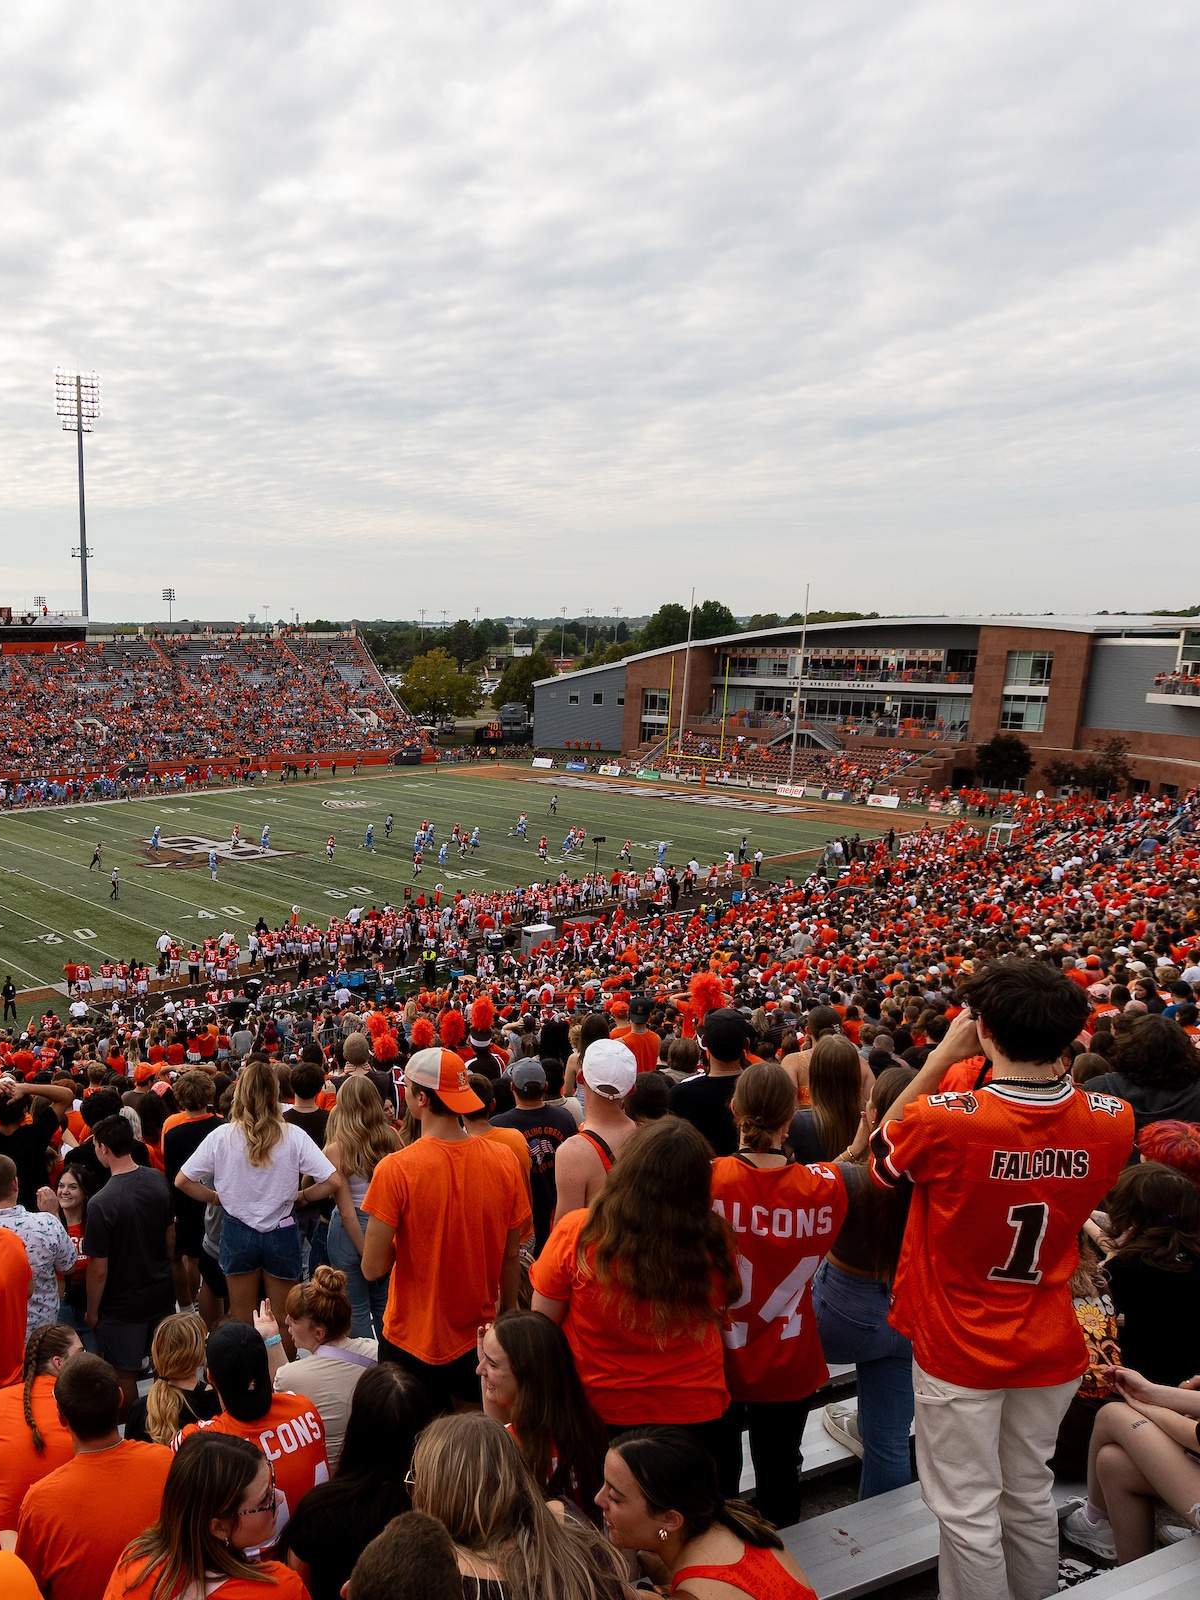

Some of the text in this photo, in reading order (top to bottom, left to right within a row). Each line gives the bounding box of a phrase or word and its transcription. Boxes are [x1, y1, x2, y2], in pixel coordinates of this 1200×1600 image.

[488, 722, 499, 731] 40
[21, 766, 110, 779] FOOTBALL
[778, 785, 803, 796] meijer
[444, 868, 487, 880] 40
[323, 885, 374, 899] 50
[198, 905, 246, 920] 40
[38, 928, 98, 945] 30
[543, 1126, 565, 1142] GREEN
[989, 1148, 1090, 1181] FALCONS
[711, 1198, 833, 1239] ALCONS
[986, 1201, 1050, 1285] 1
[259, 1411, 322, 1462] CONS
